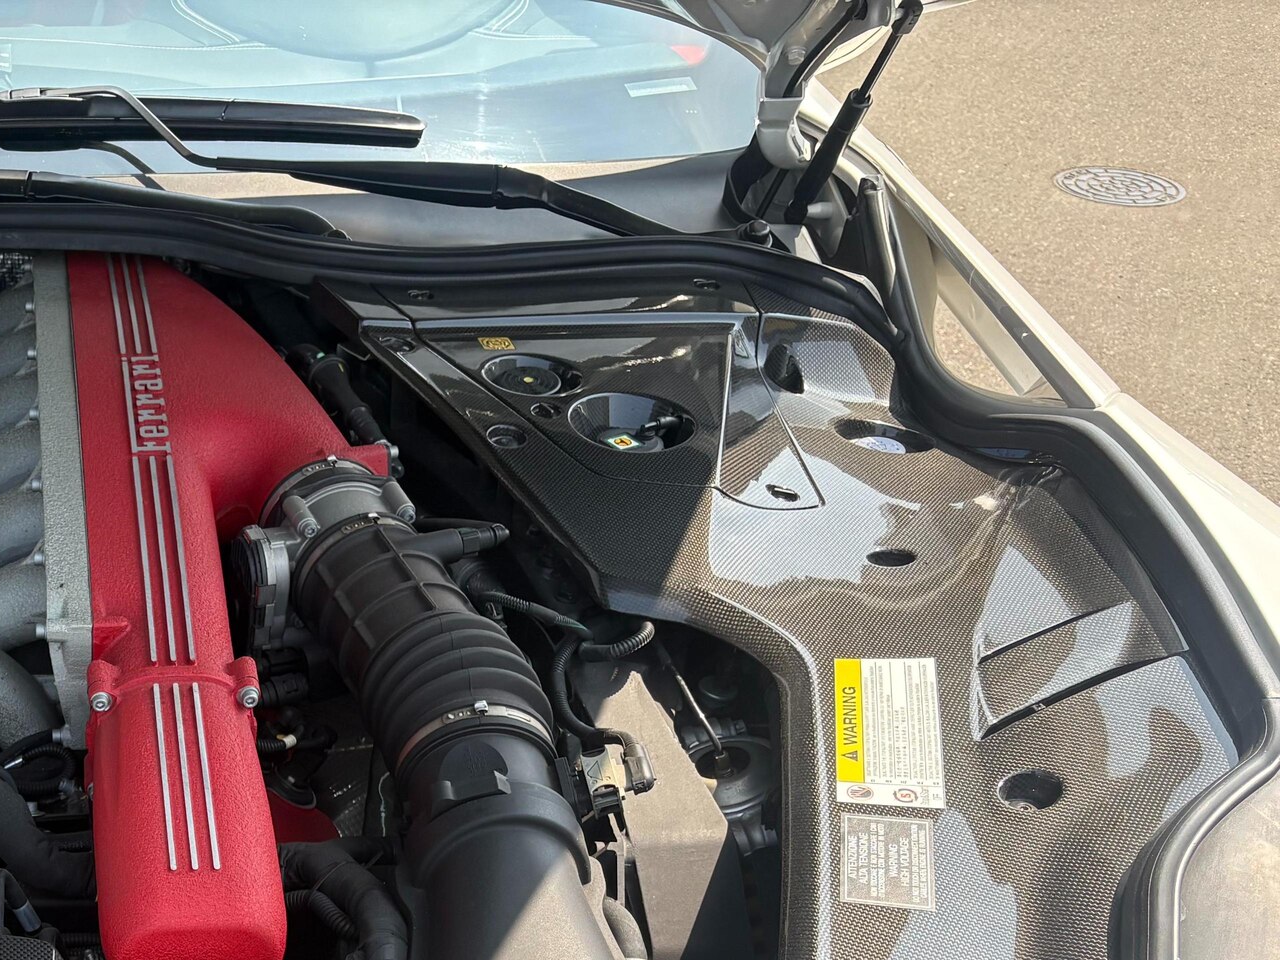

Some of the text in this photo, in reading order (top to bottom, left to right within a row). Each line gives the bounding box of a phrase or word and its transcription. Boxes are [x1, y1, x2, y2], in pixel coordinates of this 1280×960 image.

[121, 354, 172, 453] Ferrari
[842, 686, 857, 745] WARNING
[848, 835, 857, 878] ATTENZIONE
[859, 832, 868, 884] ALTA TENSIONE
[889, 844, 898, 877] WARNING
[900, 837, 909, 886] HIGH VOLTAGE
